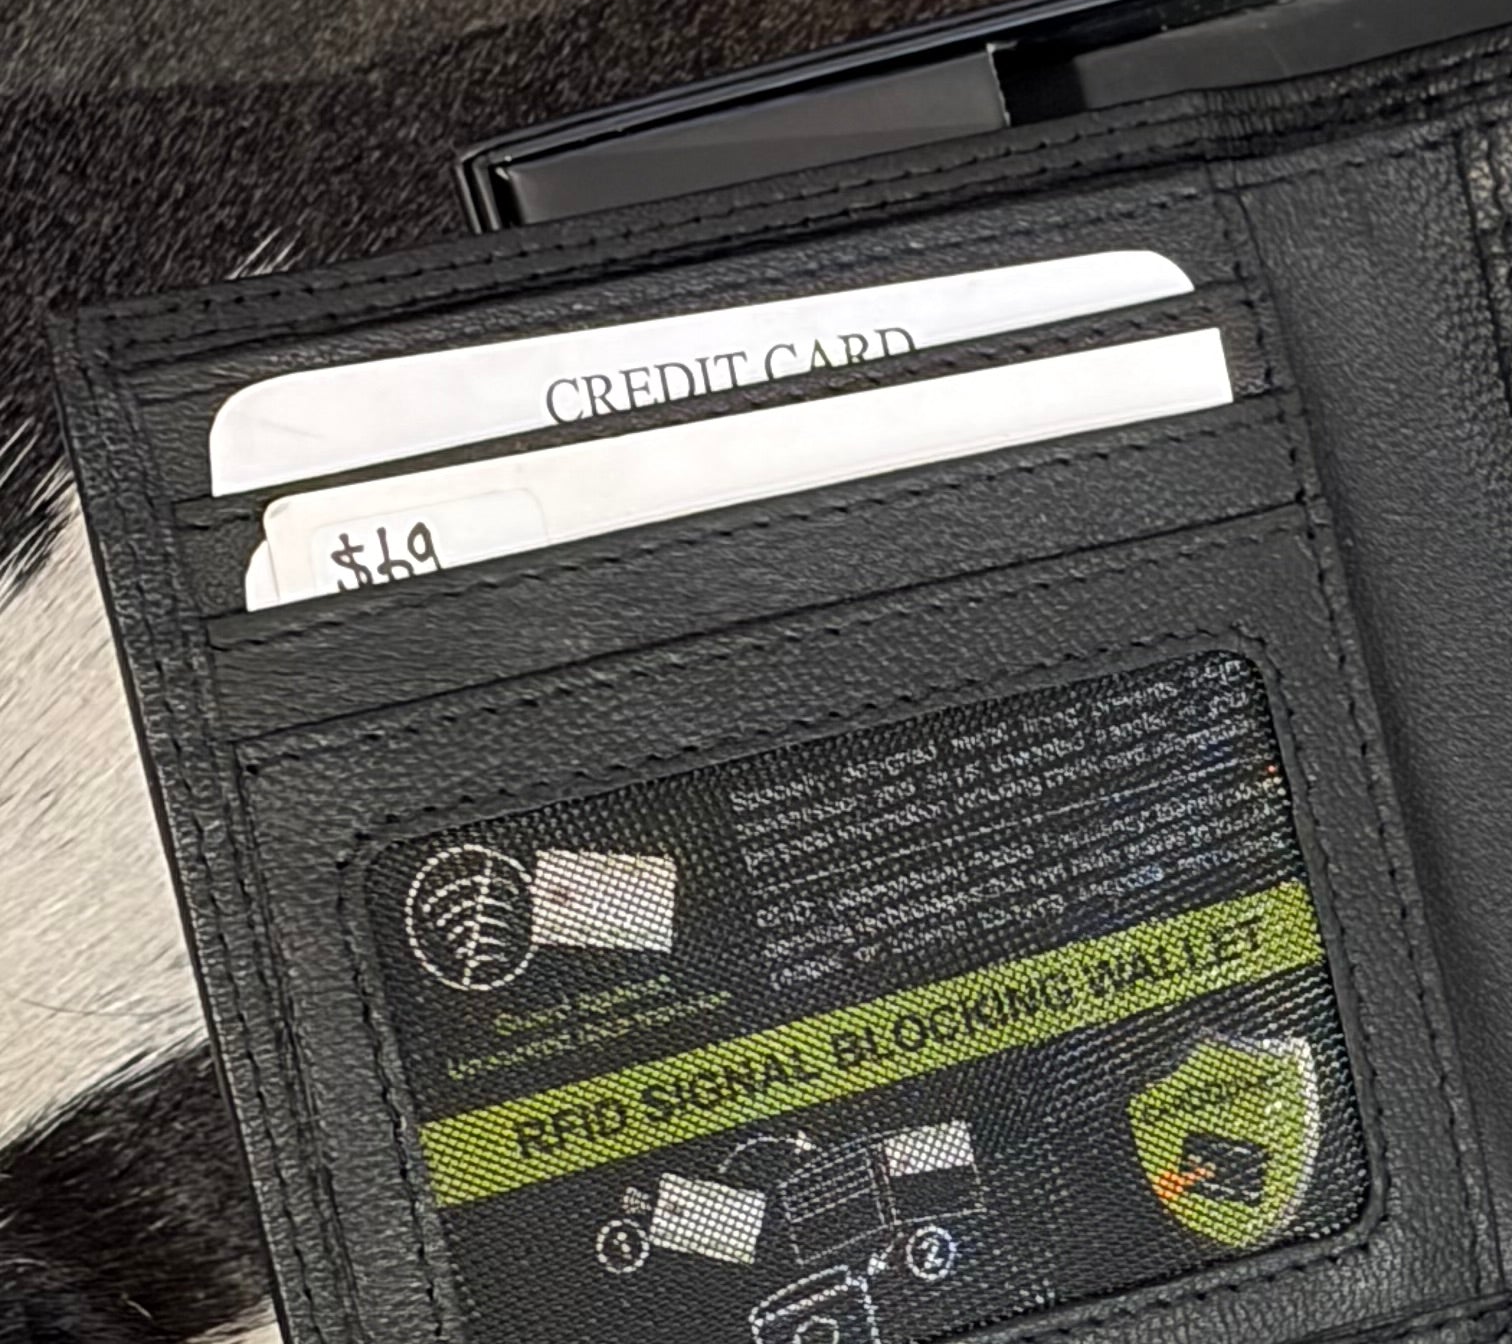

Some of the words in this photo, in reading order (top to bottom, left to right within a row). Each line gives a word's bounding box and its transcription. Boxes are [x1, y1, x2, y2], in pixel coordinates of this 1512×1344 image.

[546, 351, 747, 424] CREDIT
[764, 327, 917, 380] CARD
[516, 1097, 627, 1162] RFID
[642, 1044, 823, 1123] SIGNAL
[831, 966, 1076, 1069] BLOCKING
[1084, 918, 1262, 997] WALLET
